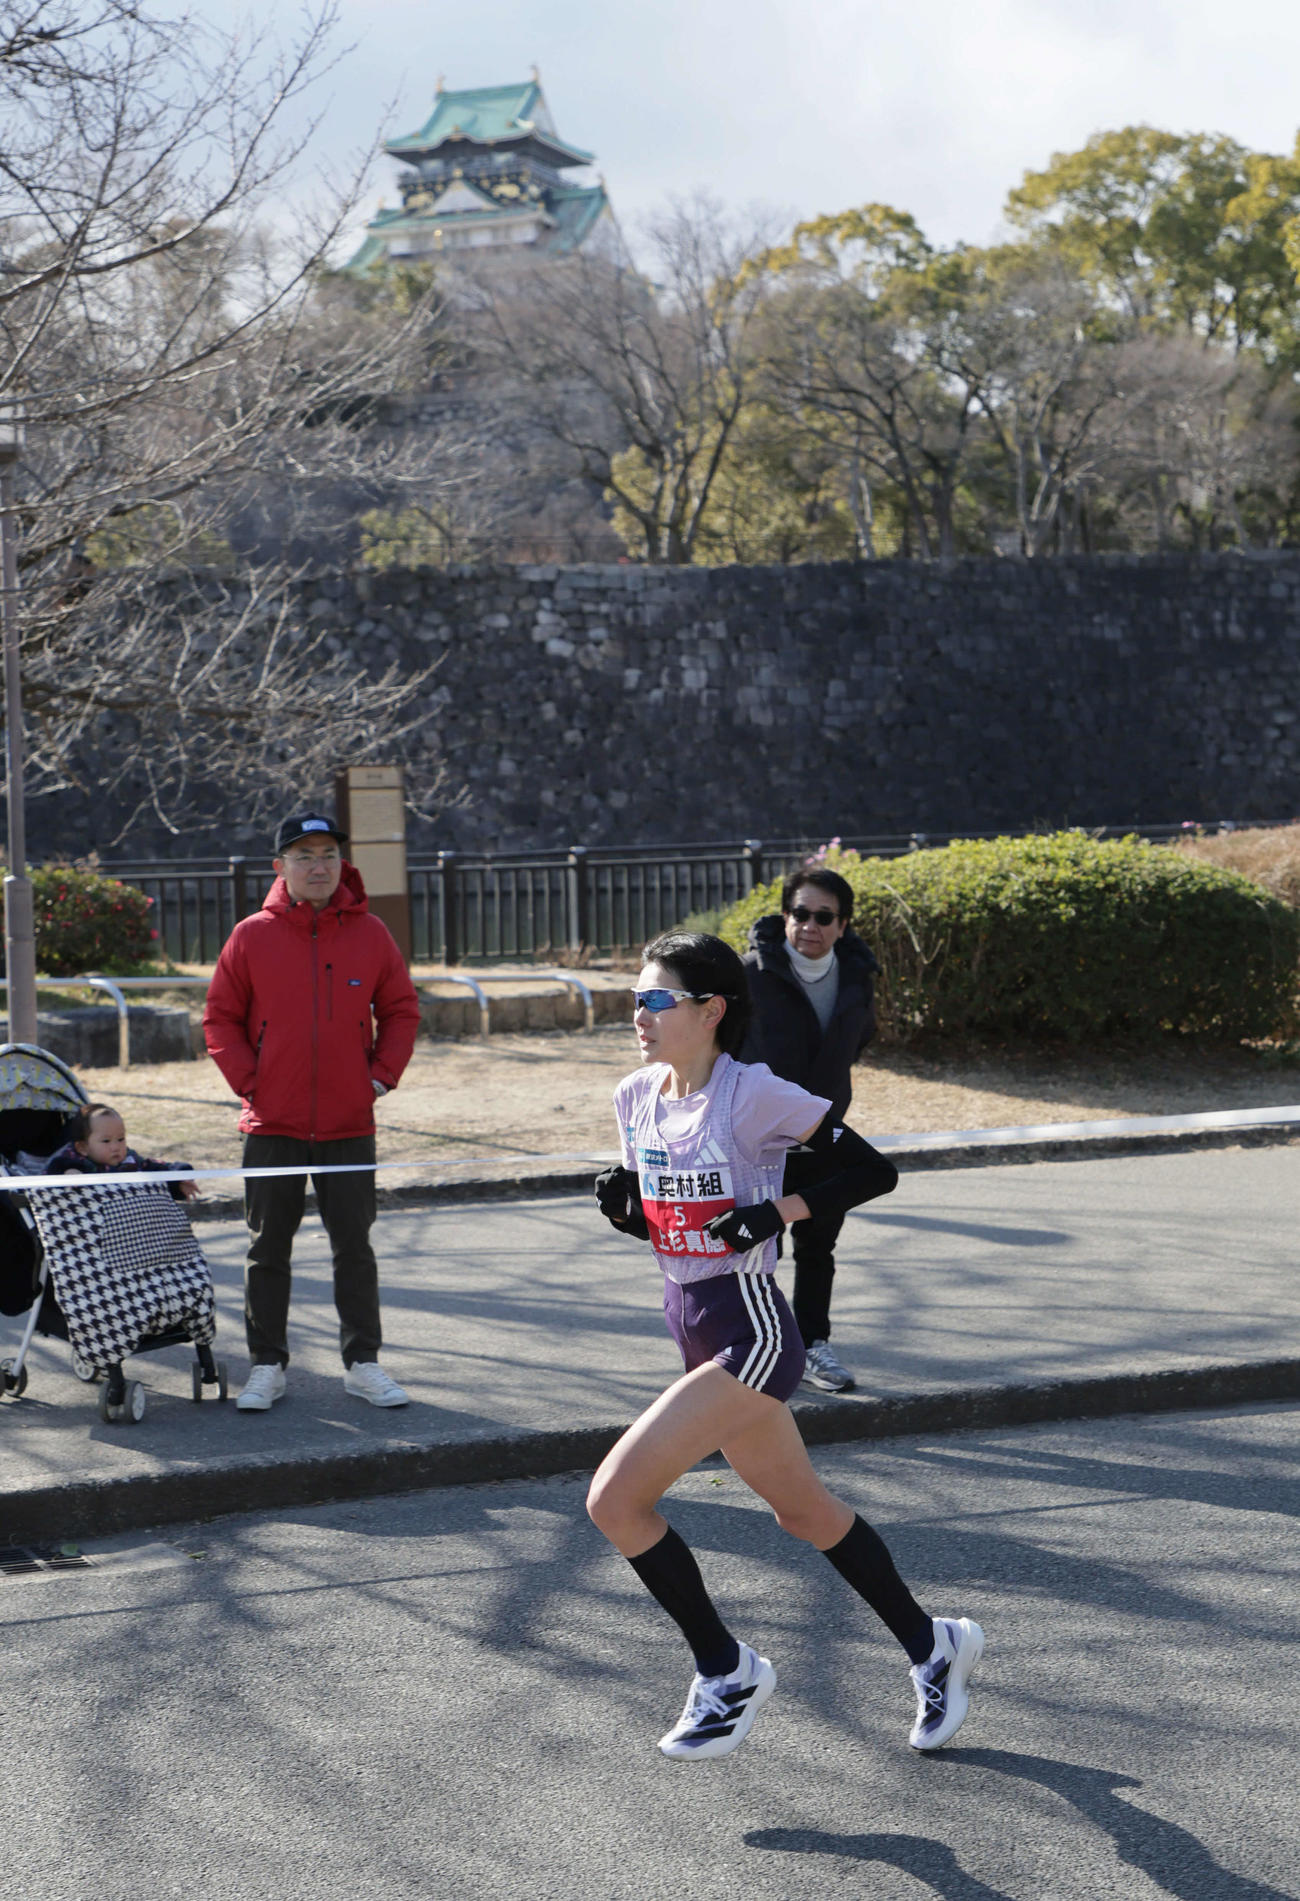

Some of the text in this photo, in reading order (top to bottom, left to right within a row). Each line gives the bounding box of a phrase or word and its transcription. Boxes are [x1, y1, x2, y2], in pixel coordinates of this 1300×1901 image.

[658, 1172, 725, 1197] 奥村組
[674, 1206, 686, 1227] 5
